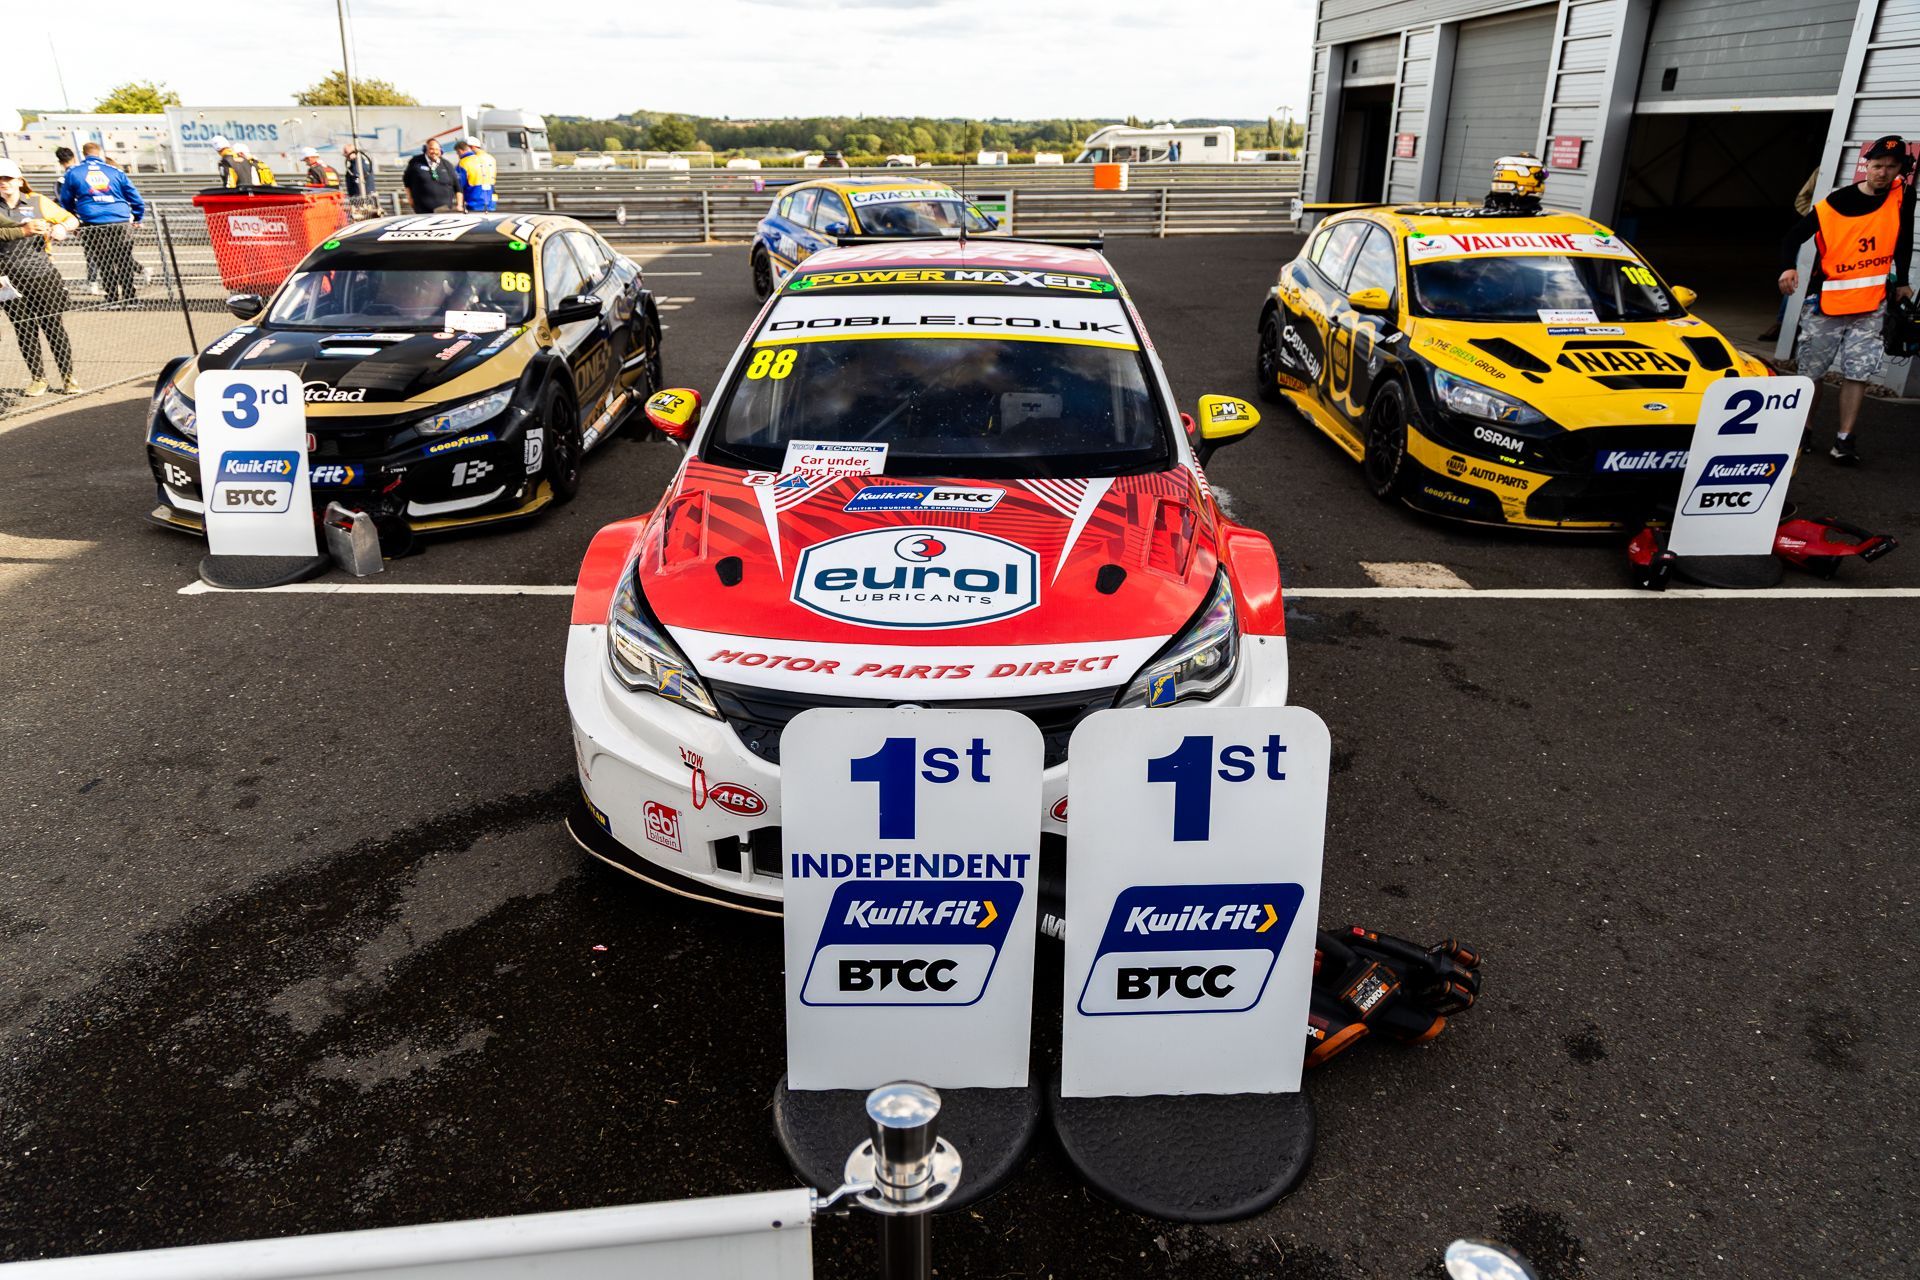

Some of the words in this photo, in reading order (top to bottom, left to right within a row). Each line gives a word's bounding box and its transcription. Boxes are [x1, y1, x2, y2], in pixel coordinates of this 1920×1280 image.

[1450, 233, 1582, 253] VALVOLINE
[1858, 236, 1876, 253] 31
[1858, 255, 1893, 269] SPORT
[501, 271, 531, 293] 66
[812, 270, 946, 286] POWER
[1621, 266, 1657, 287] 116
[768, 315, 1125, 336] DOBLE.CO.UK
[746, 349, 798, 380] 88
[1434, 339, 1450, 350] THE
[1449, 348, 1478, 363] GREEN
[1474, 359, 1506, 380] GROUP
[1574, 351, 1678, 373] NAPA
[222, 383, 288, 429] 3rd
[1210, 402, 1246, 416] PMR
[1717, 388, 1801, 435] 2nd
[430, 434, 489, 453] GOODYEAR
[1474, 426, 1524, 453] OSRAM
[793, 465, 823, 477] Parc
[801, 455, 824, 465] Car
[827, 456, 869, 466] under
[1470, 467, 1497, 482] AUTO
[1497, 473, 1529, 490] PARTS
[225, 489, 277, 506] BTCC
[933, 492, 993, 503] BTCC
[1699, 491, 1753, 508] BTCC
[814, 563, 1018, 595] eurol
[839, 593, 992, 605] LUBRICANTS
[706, 649, 841, 675] MOTOR
[852, 663, 975, 679] PARTS
[986, 655, 1119, 678] DIRECT
[686, 750, 704, 769] TOW
[850, 737, 991, 840] 1st
[1147, 734, 1287, 842] 1st
[716, 790, 759, 810] ABS
[649, 829, 677, 847] bilstein
[791, 853, 1031, 878] INDEPENDENT
[838, 959, 959, 992] BTCC
[1116, 964, 1237, 1000] BTCC
